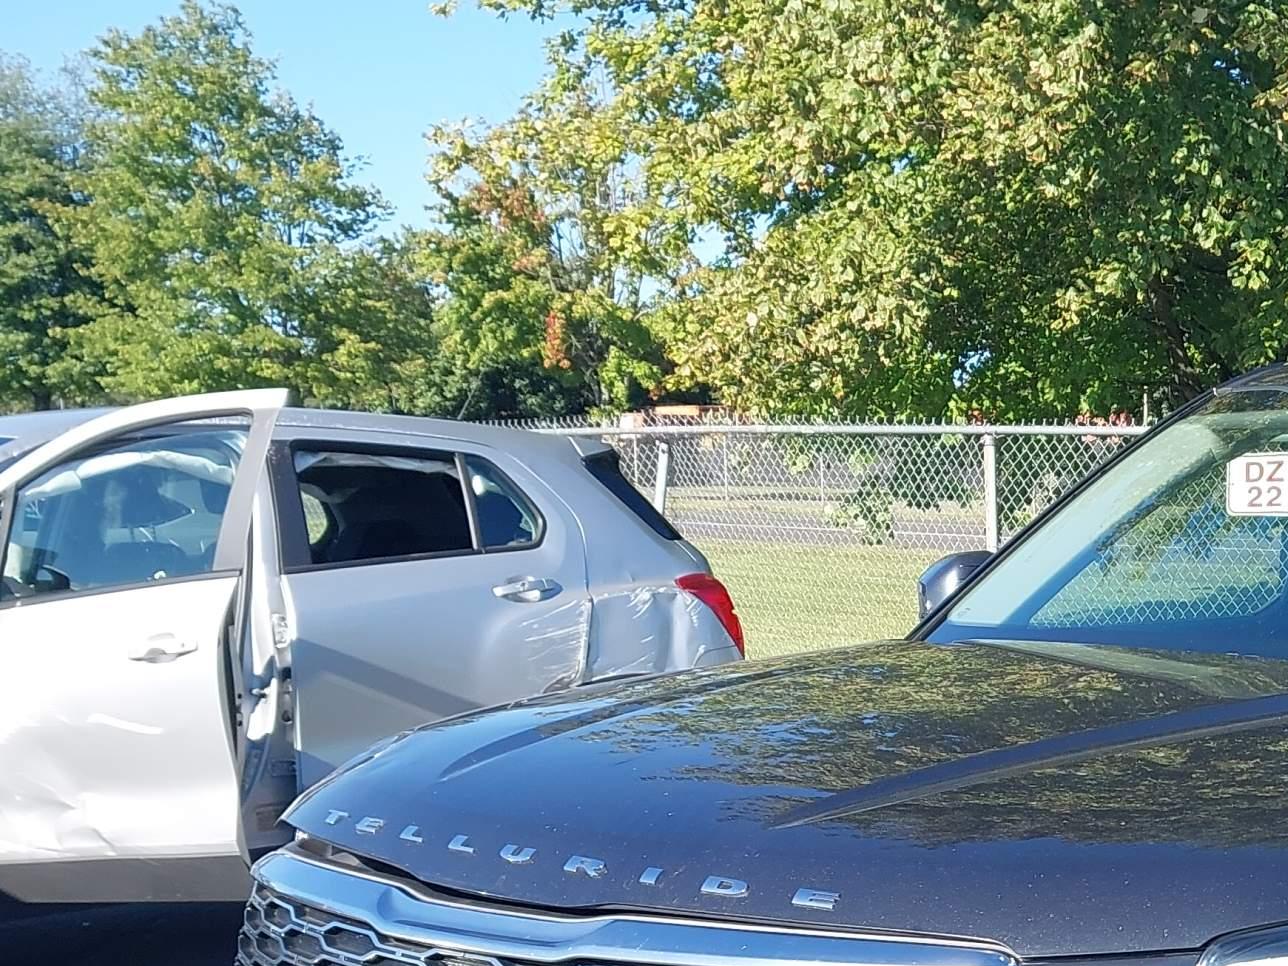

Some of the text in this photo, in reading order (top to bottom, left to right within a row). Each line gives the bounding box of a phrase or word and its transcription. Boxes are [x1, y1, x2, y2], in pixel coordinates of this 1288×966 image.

[1245, 460, 1284, 482] DZ
[1247, 486, 1282, 507] 22
[324, 808, 842, 910] TELLURIDE
